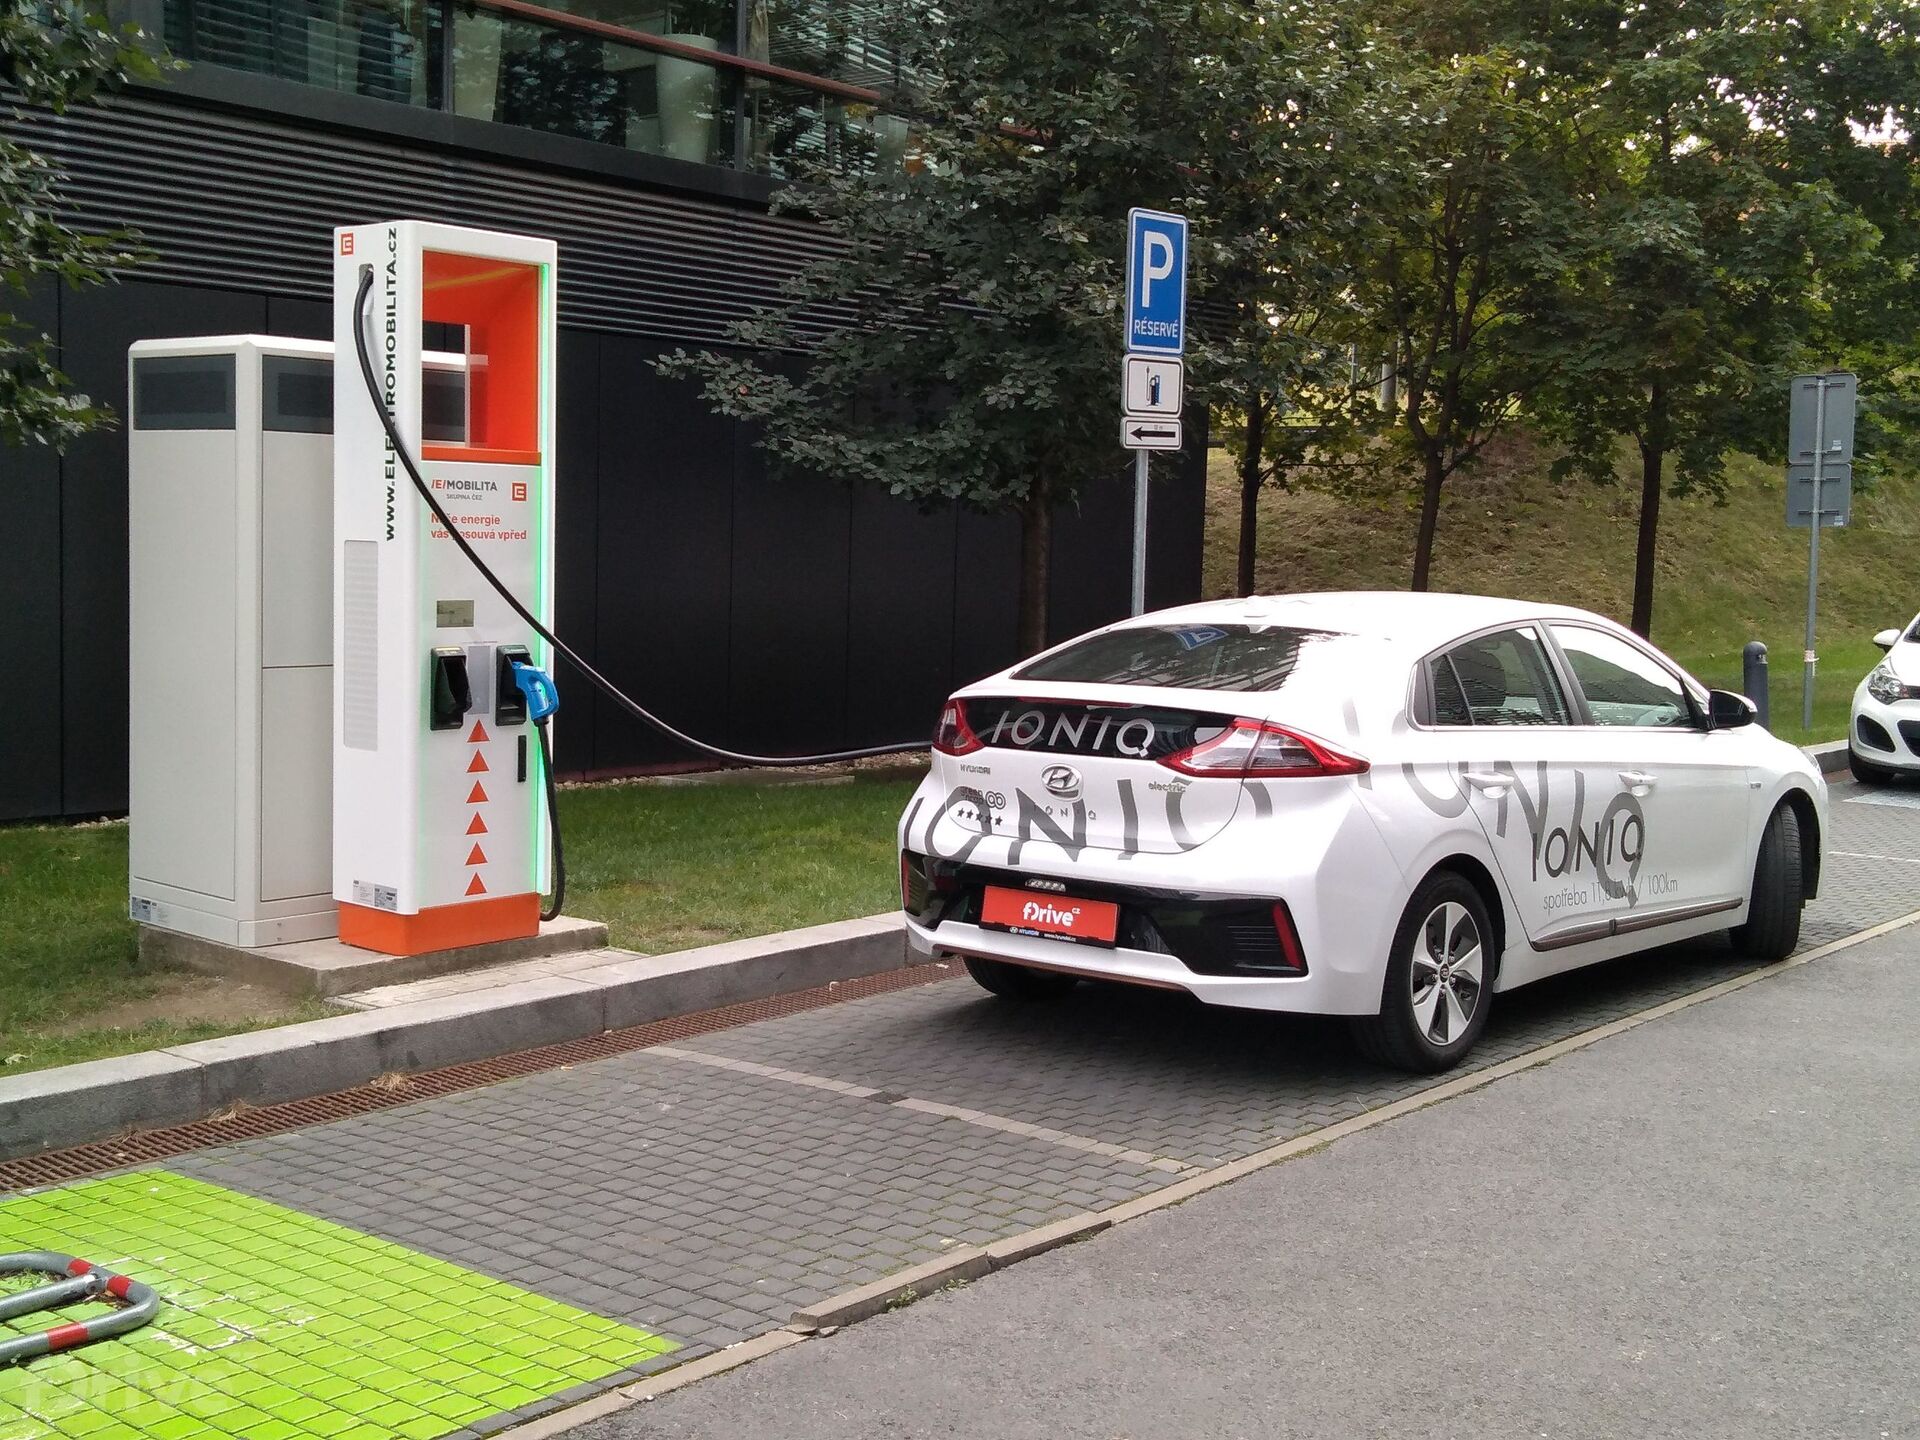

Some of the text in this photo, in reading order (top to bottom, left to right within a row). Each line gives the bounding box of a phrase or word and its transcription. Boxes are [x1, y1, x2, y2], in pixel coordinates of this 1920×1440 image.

[1142, 230, 1174, 308] P
[1133, 316, 1178, 338] RÉSERVÉ
[446, 492, 483, 501] SKUPINA ČEZ
[431, 512, 501, 526] Ne energie
[431, 529, 527, 541] vás osouvá vpřed
[991, 710, 1156, 758] IONIQ
[960, 764, 991, 775] HYUNDAI
[1148, 780, 1186, 793] electric
[1532, 814, 1643, 882] IONIQ
[1543, 883, 1587, 916] spotřeba
[1648, 872, 1678, 896] 100km
